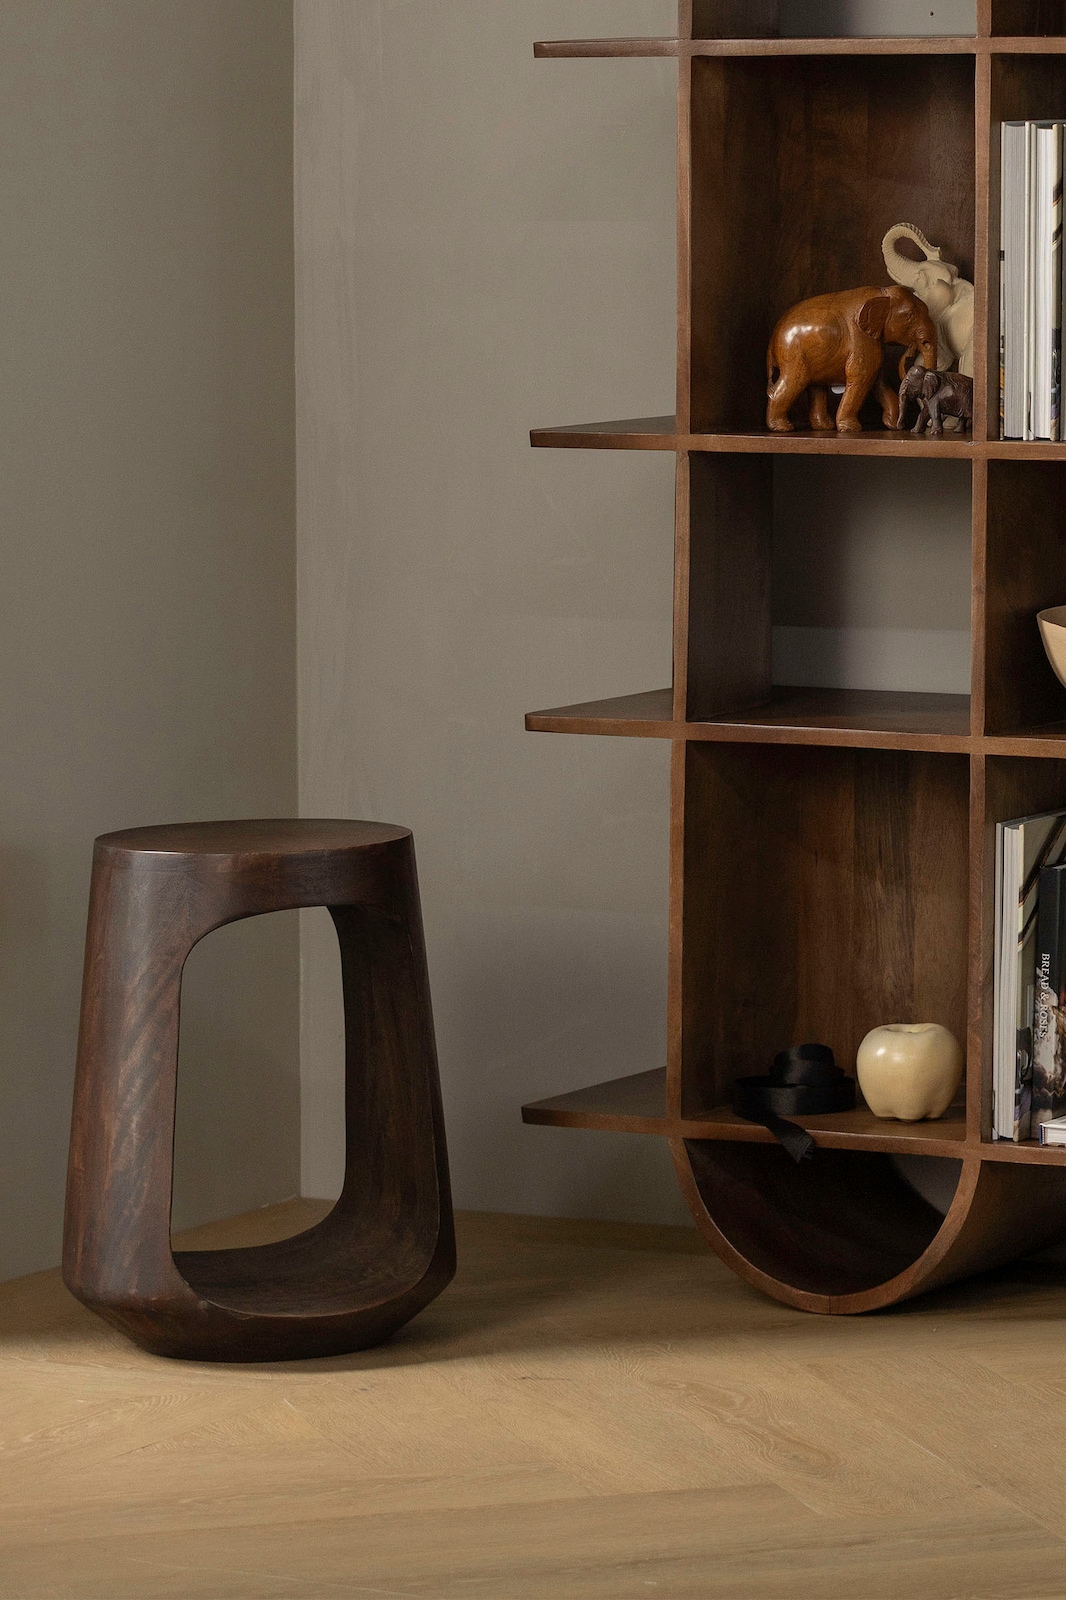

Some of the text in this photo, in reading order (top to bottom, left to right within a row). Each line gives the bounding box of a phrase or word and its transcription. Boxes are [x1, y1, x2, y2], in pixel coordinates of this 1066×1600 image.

[1040, 953, 1050, 1038] BREAD & ROSES
